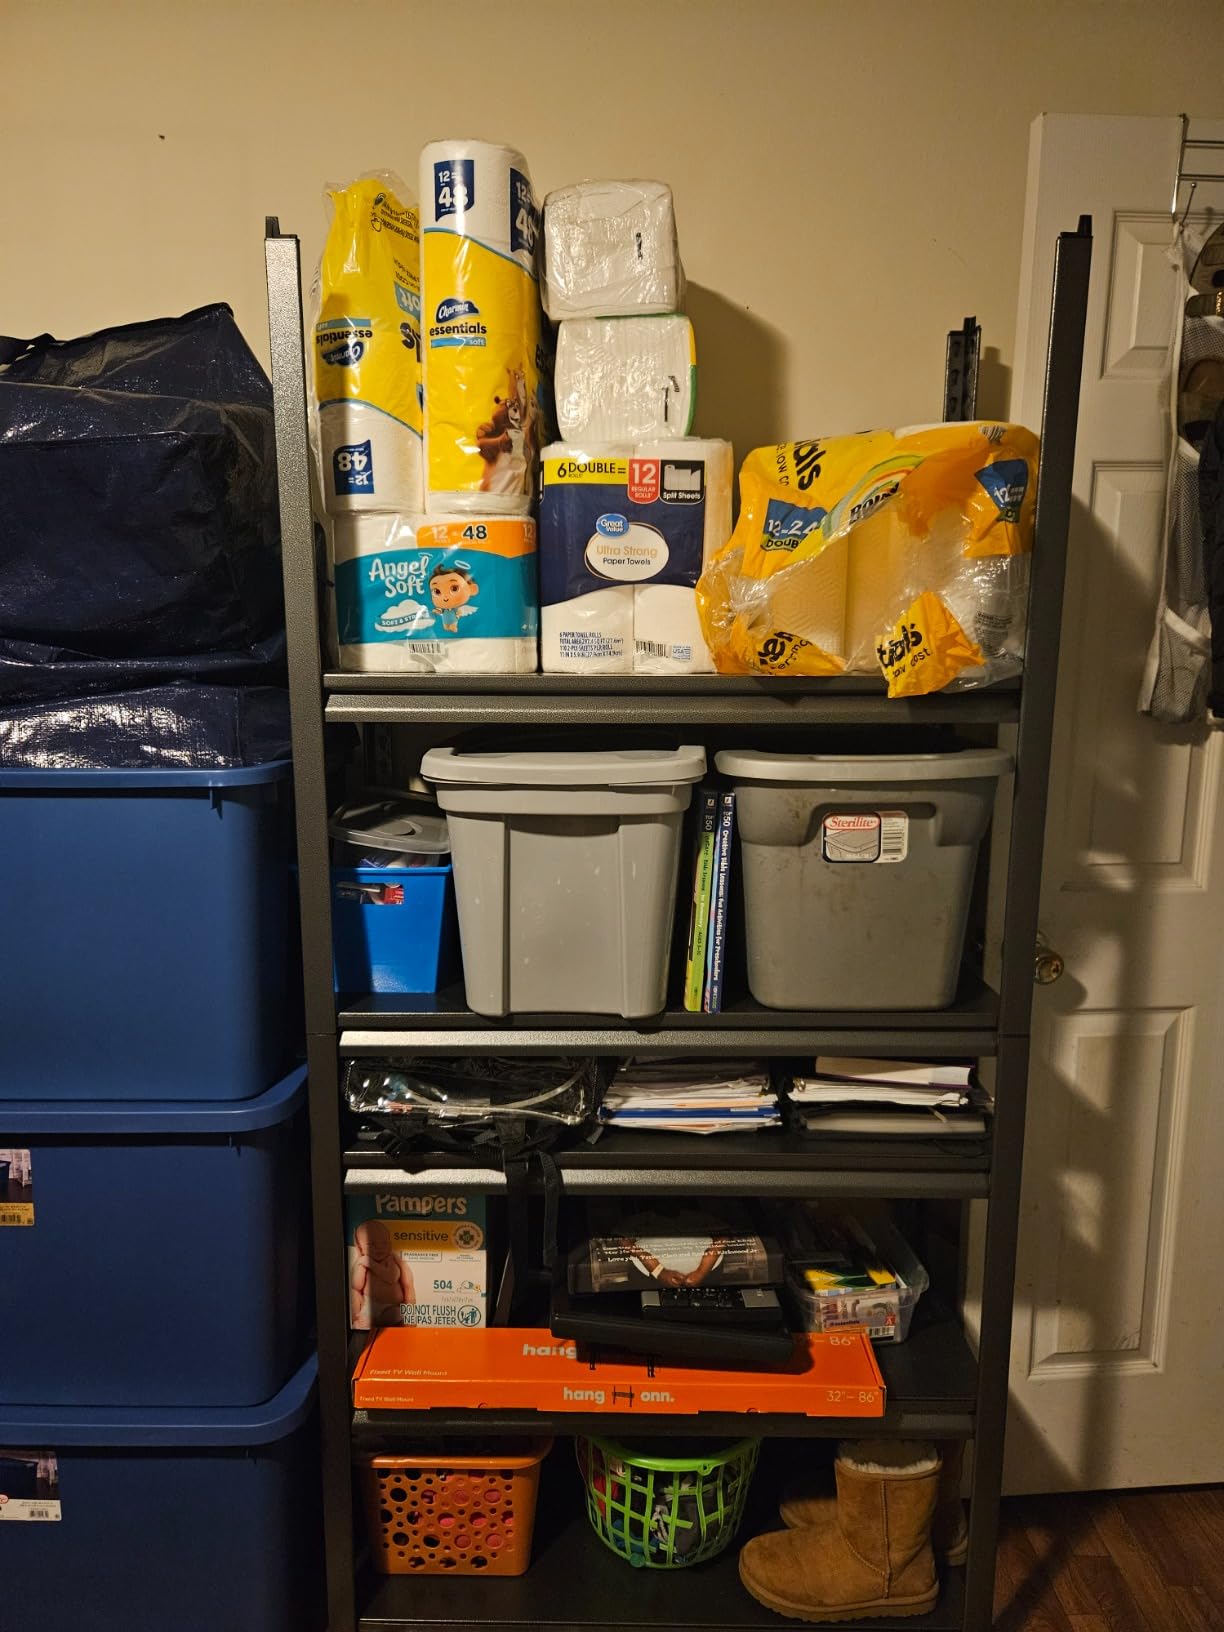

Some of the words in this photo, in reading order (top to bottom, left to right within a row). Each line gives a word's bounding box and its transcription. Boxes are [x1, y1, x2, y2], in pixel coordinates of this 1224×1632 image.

[438, 185, 469, 208] 48
[438, 303, 469, 319] Charmin
[430, 322, 487, 336] essentials
[338, 452, 368, 471] 48
[557, 463, 567, 478] 6
[568, 462, 616, 474] DOUBLE
[632, 463, 657, 485] 12
[662, 491, 678, 501] Split
[679, 491, 701, 500] Sheets
[600, 518, 624, 529] Great
[462, 525, 488, 540] 48
[596, 545, 621, 555] Ultra
[623, 545, 658, 559] Strong
[368, 555, 429, 581] Angel
[602, 557, 626, 566] Paper
[627, 557, 651, 566] Towels
[384, 575, 425, 598] Soft
[381, 619, 399, 627] SOFT
[722, 816, 731, 827] 50
[830, 815, 873, 828] Sterilite
[721, 830, 730, 857] Creative
[720, 857, 729, 872] Bible
[716, 908, 724, 936] Activities
[713, 945, 721, 981] Preschoolers
[375, 1194, 468, 1216] Pampers
[393, 1227, 449, 1242] sensitive
[433, 1279, 453, 1290] 504
[400, 1305, 413, 1315] DO
[413, 1305, 430, 1315] NOT
[432, 1304, 457, 1315] FLUSH
[404, 1316, 416, 1325] NE
[417, 1316, 432, 1325] PAS
[434, 1316, 457, 1325] JETER
[522, 1343, 577, 1360] hang
[563, 1387, 605, 1405] hang
[640, 1391, 676, 1403] onn.
